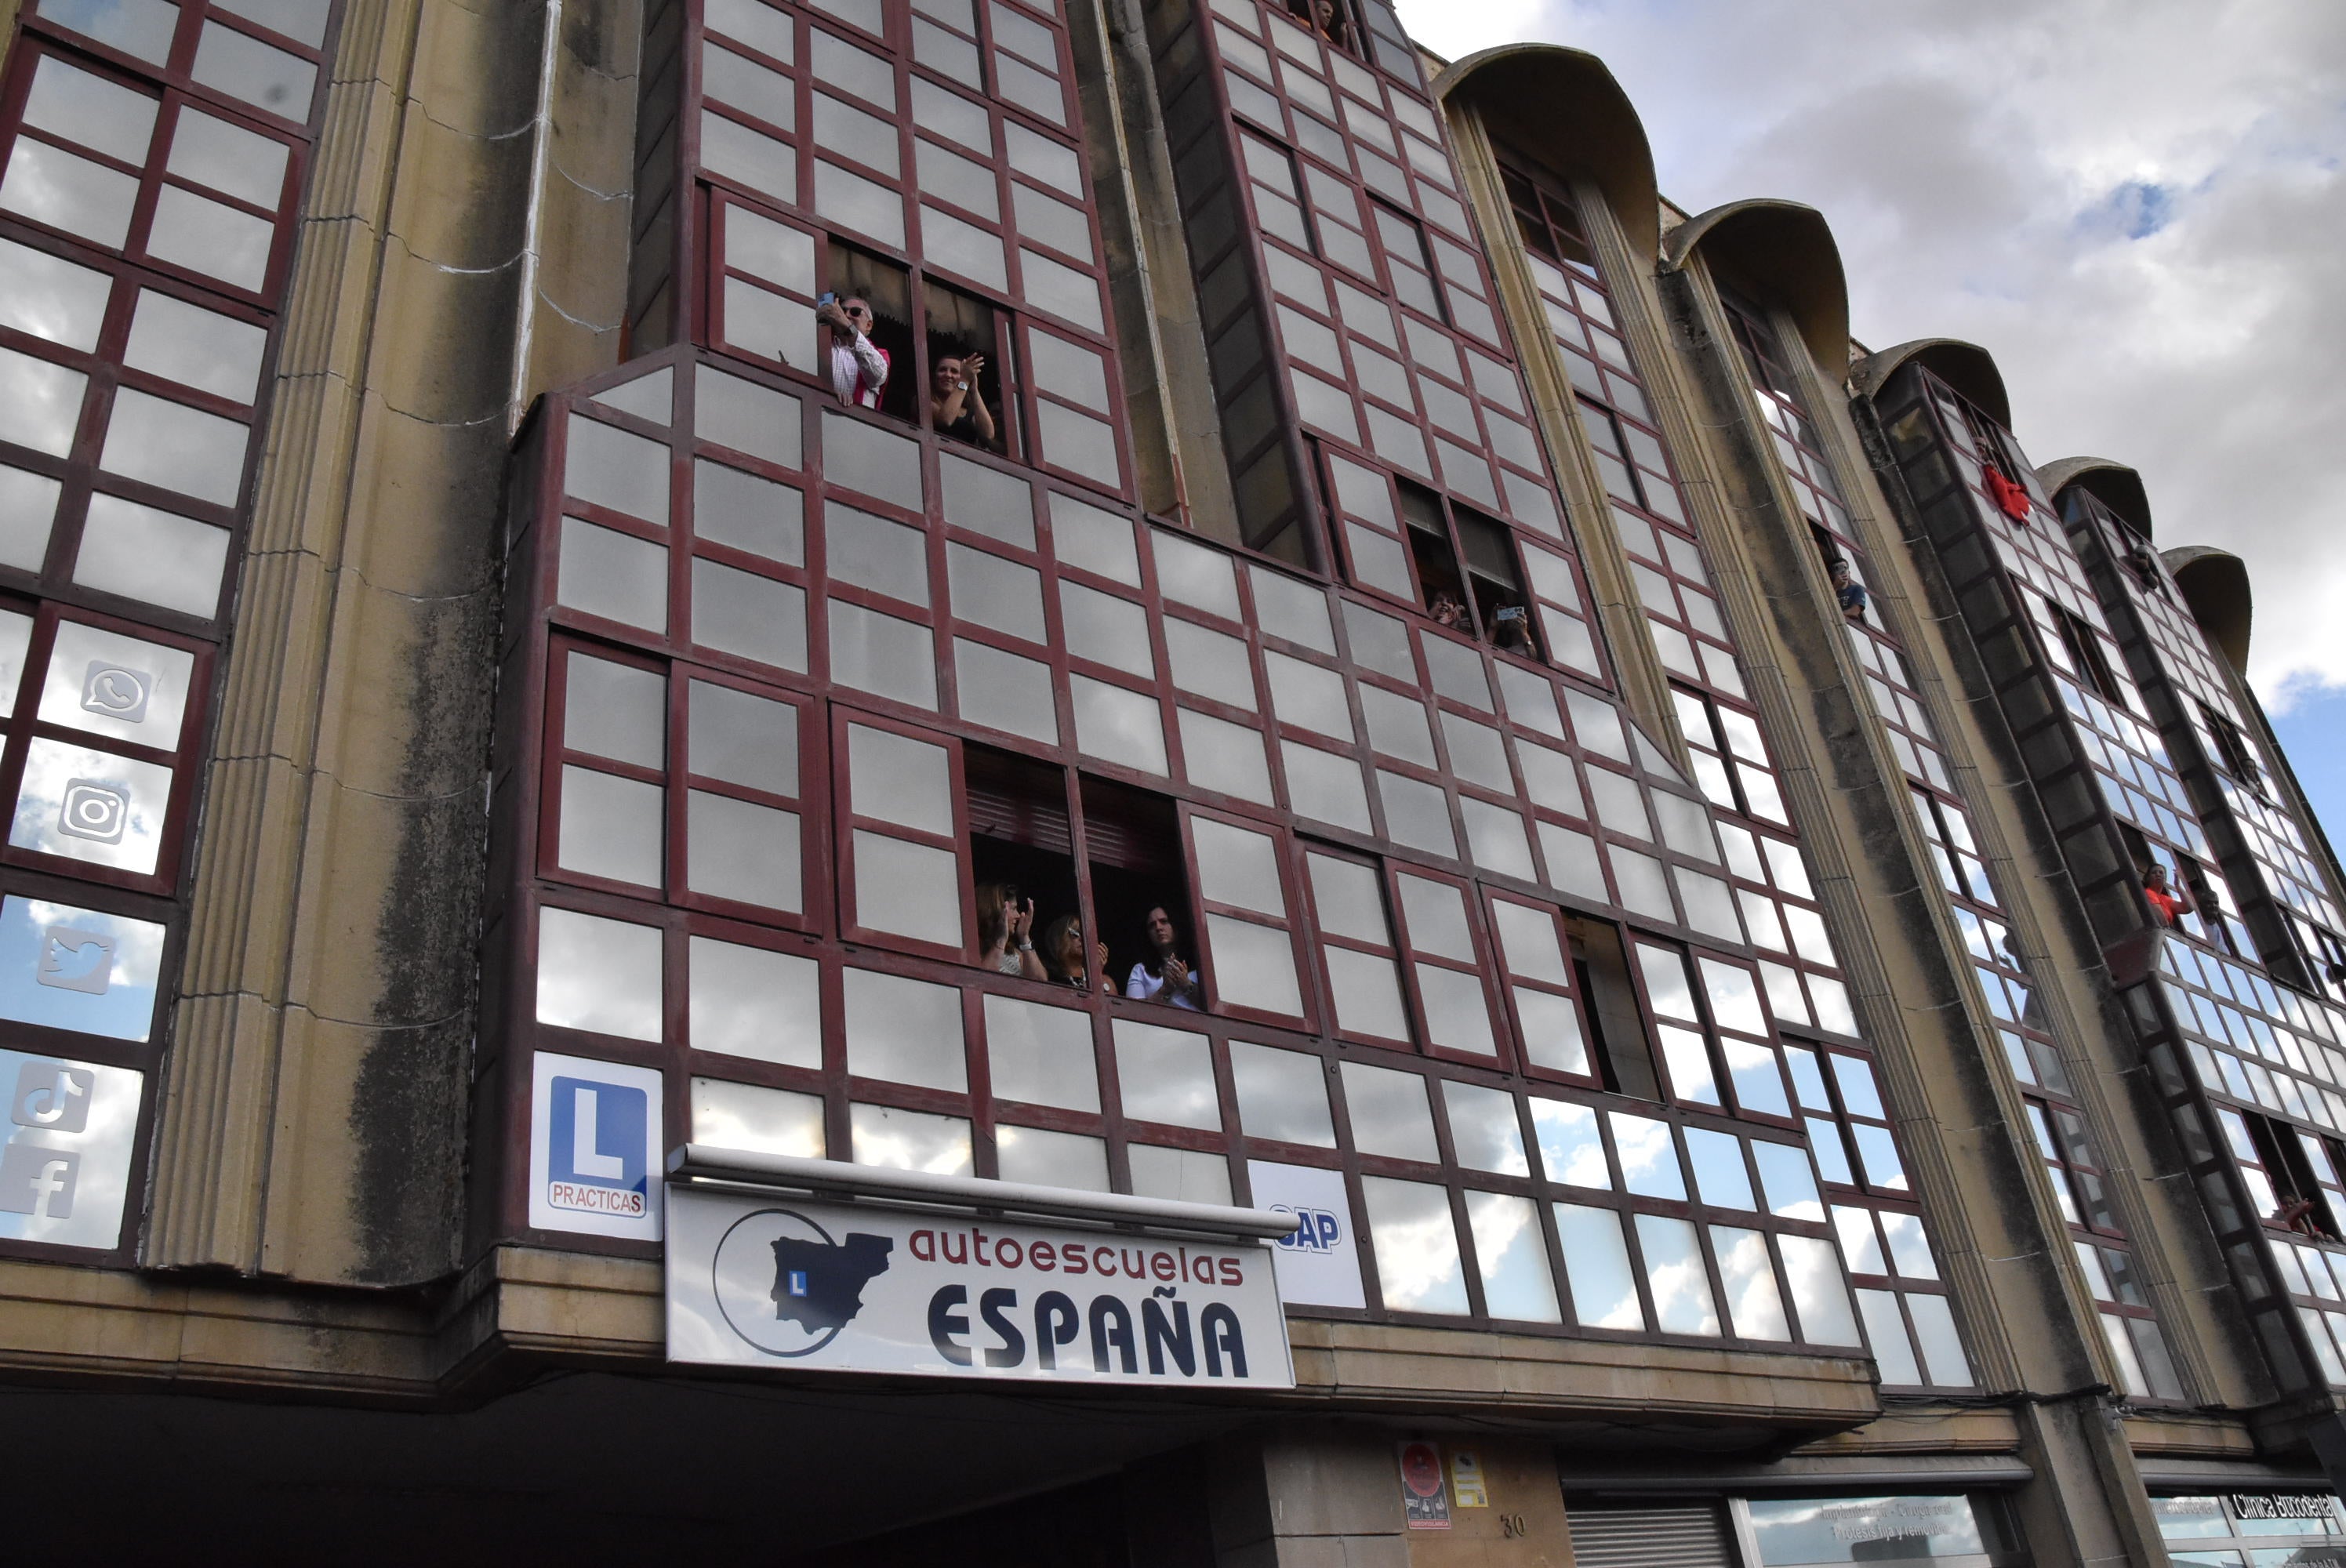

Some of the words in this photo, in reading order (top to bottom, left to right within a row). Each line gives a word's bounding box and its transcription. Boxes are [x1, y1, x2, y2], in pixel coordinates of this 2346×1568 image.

[573, 1087, 623, 1180] L
[553, 1184, 641, 1213] PRACTICAS
[909, 1228, 1244, 1287] autoescuelas
[792, 1273, 804, 1294] L
[928, 1284, 1249, 1377] ESPAÑA
[2272, 1494, 2337, 1518] Bucodental
[1500, 1512, 1525, 1538] 30
